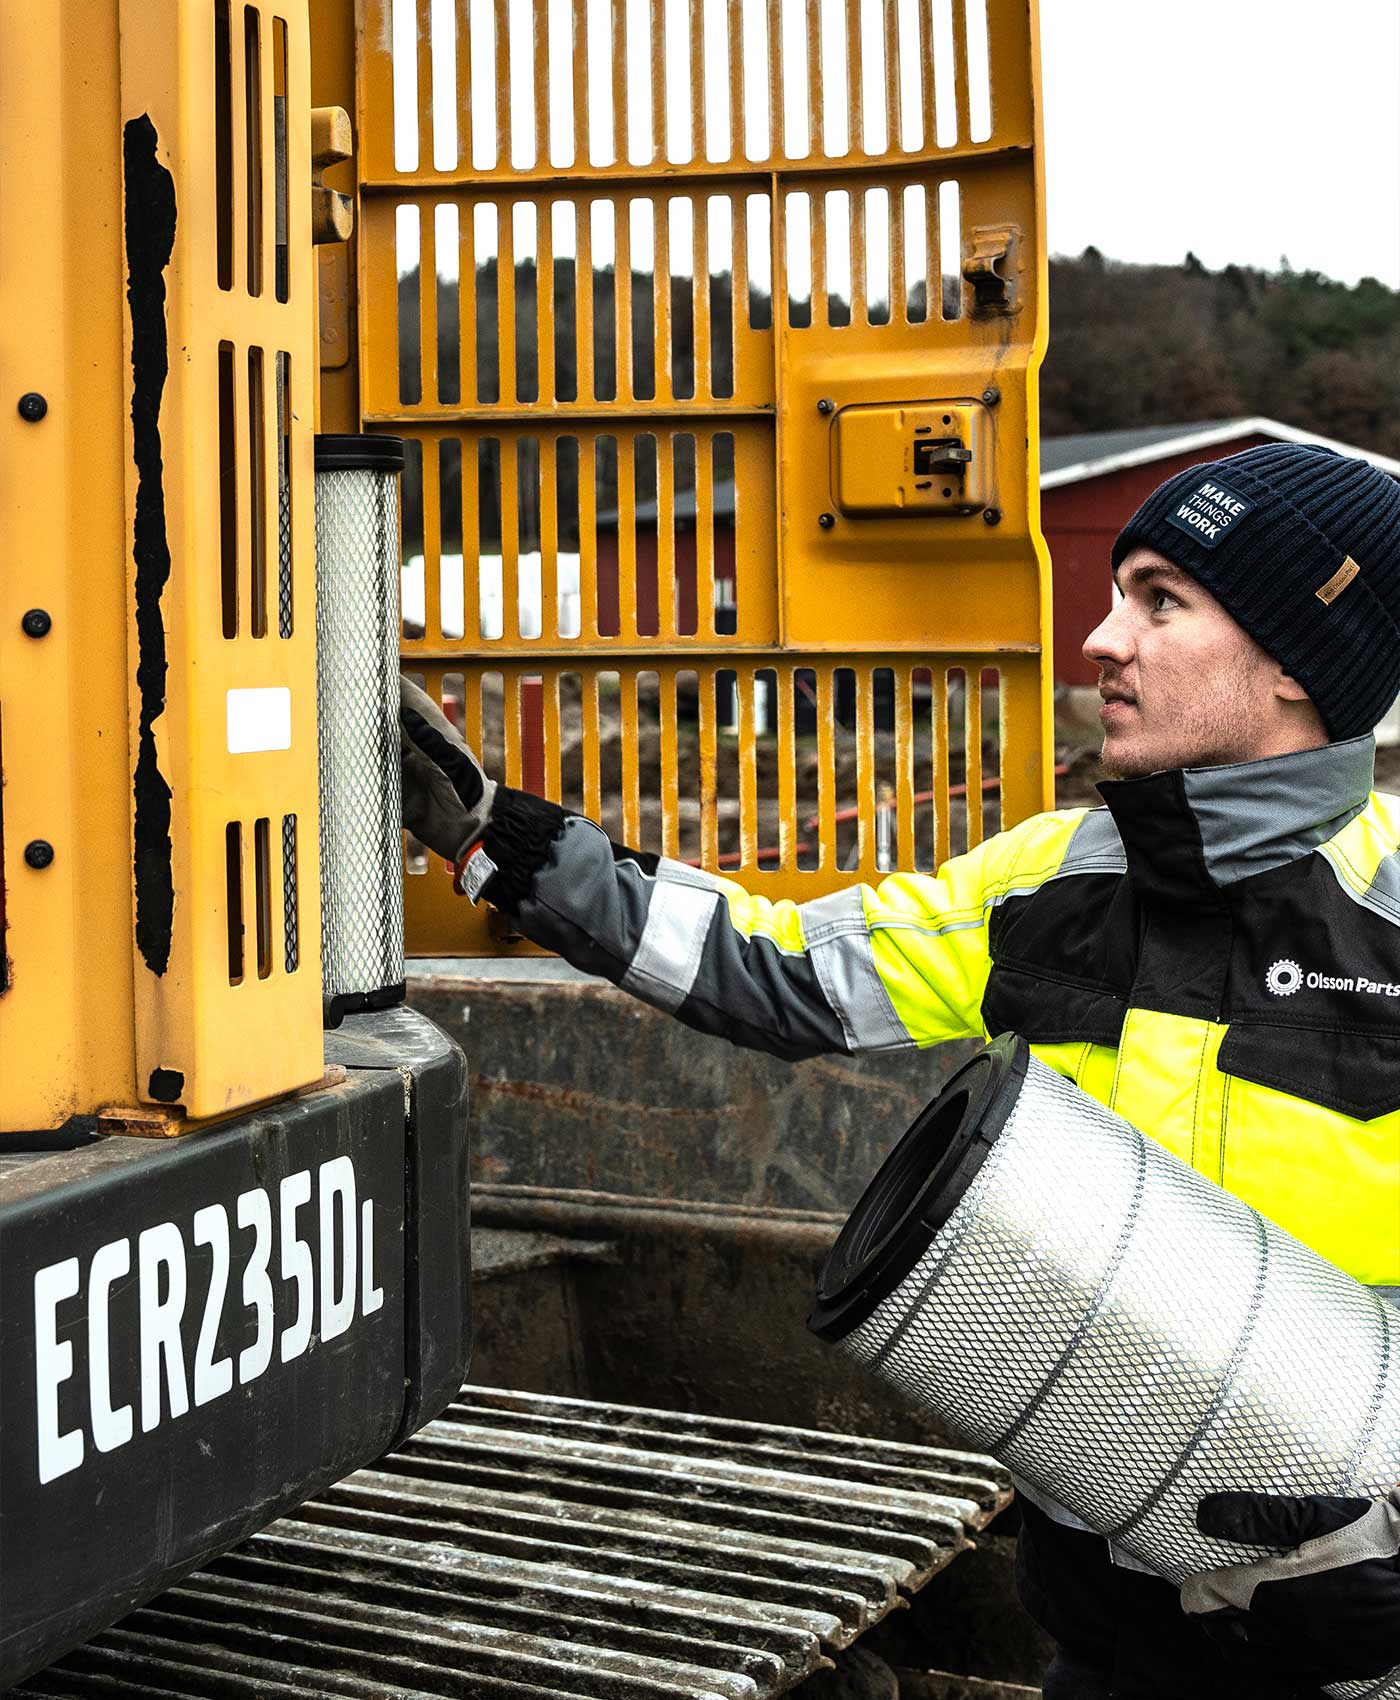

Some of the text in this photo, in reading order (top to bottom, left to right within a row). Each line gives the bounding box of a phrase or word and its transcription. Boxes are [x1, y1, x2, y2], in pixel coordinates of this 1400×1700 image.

[1188, 494, 1232, 527] THINGS
[1198, 483, 1246, 517] MAKE
[1176, 504, 1222, 540] WORK
[1306, 972, 1400, 997] Olsson Parts
